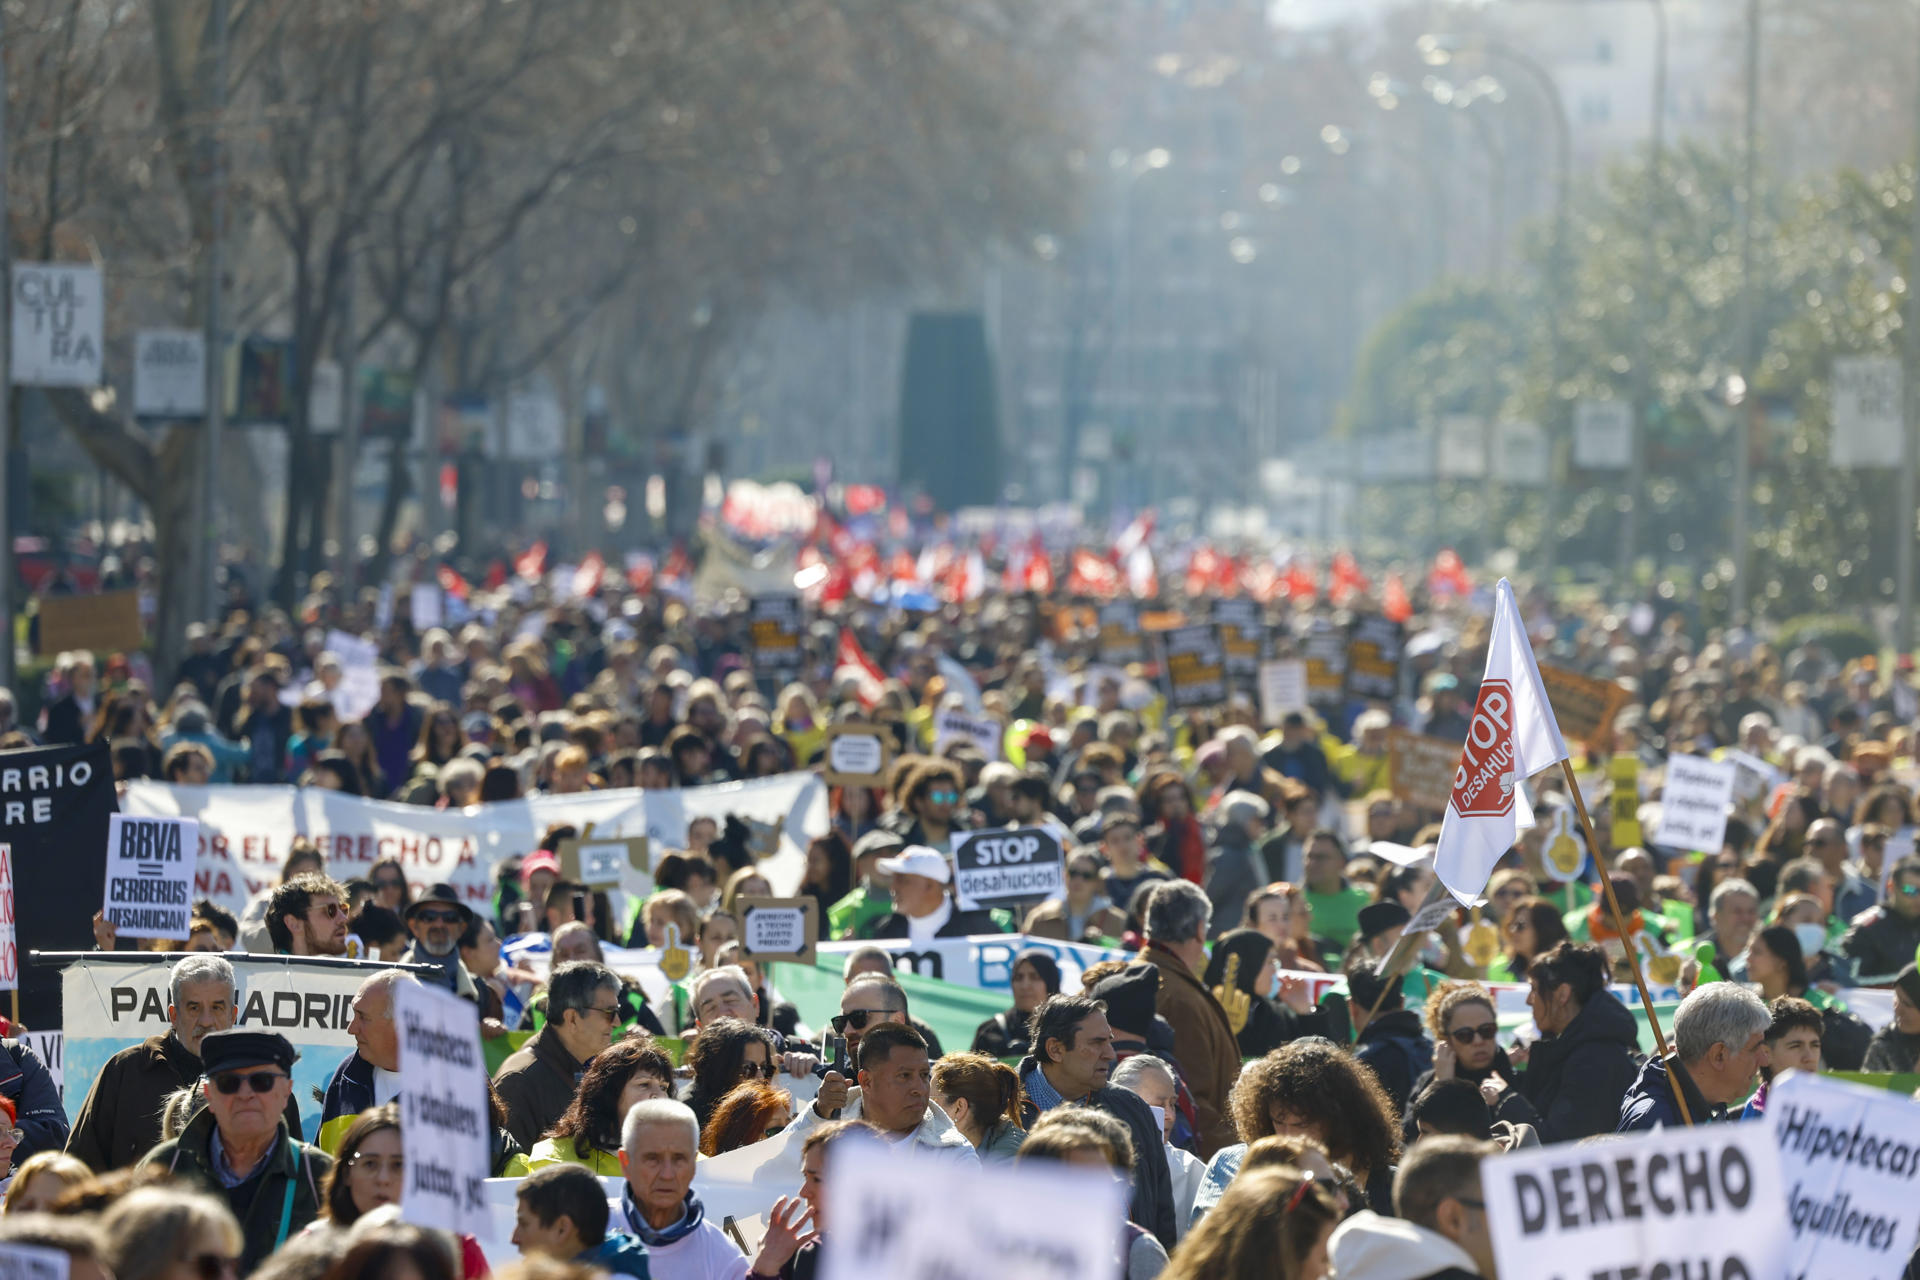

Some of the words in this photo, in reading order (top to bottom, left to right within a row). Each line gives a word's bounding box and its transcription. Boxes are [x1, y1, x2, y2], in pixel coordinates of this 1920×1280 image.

[16, 271, 87, 308] CUL
[2, 761, 92, 793] RRIO
[5, 797, 52, 826] RE
[119, 821, 182, 862] BBVA
[243, 835, 278, 862] EL
[457, 836, 475, 867] A
[975, 836, 1040, 866] STOP
[110, 877, 187, 905] CERBERUS
[108, 907, 186, 932] DESAHUCIAN
[111, 987, 172, 1022] PA
[235, 989, 355, 1030] ADRI
[1513, 1144, 1752, 1236] DERECHO
